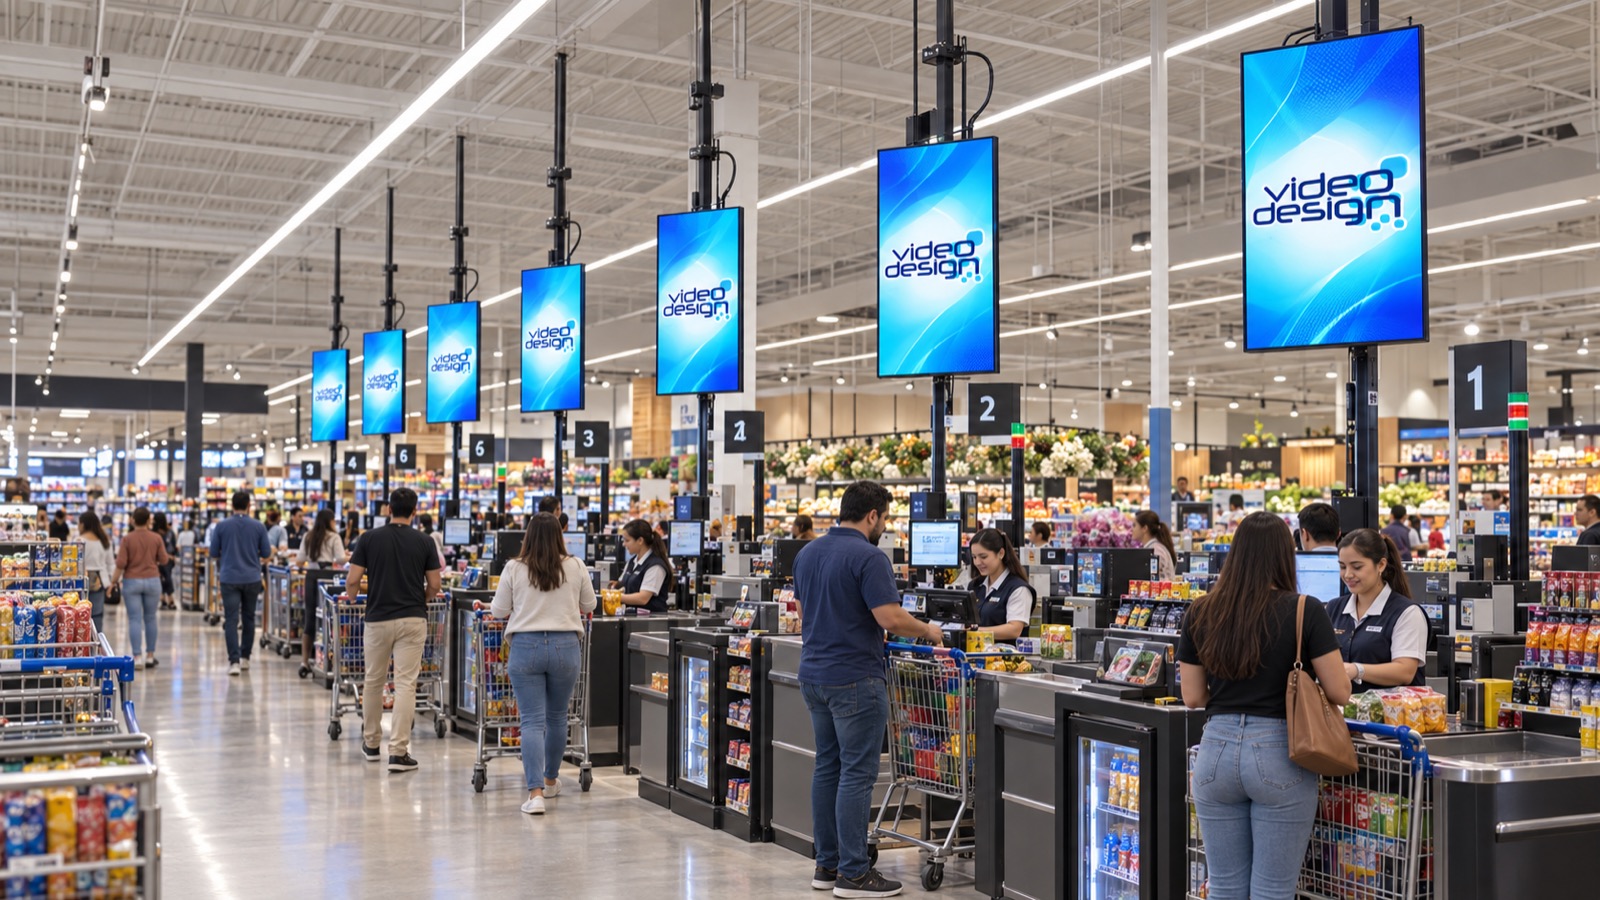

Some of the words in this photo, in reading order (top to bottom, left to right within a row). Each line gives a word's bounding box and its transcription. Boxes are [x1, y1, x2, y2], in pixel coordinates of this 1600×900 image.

[1264, 169, 1394, 203] video
[1253, 195, 1401, 227] design
[892, 240, 975, 261] video
[885, 257, 980, 280] design
[668, 287, 726, 303] video
[663, 301, 729, 318] design
[528, 326, 571, 339] video
[525, 337, 574, 351] design
[433, 352, 469, 363] video
[431, 361, 471, 373] design
[1467, 365, 1483, 411] 1
[979, 396, 995, 422] 2
[584, 430, 594, 448] 3
[399, 449, 408, 463] 6
[475, 440, 485, 457] 6
